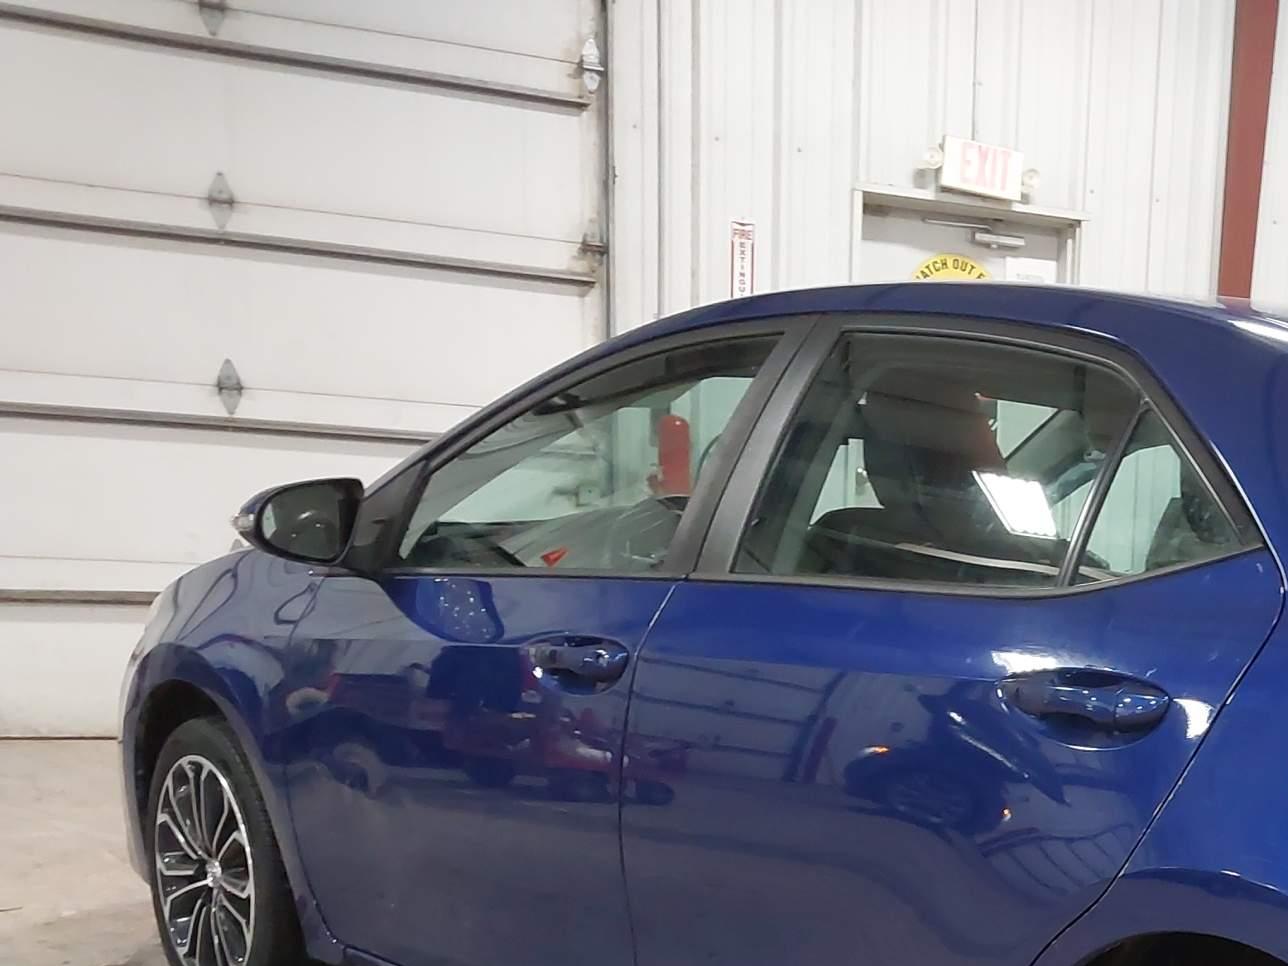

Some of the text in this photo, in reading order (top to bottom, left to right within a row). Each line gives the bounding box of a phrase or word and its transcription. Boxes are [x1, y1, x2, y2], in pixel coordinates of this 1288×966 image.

[960, 141, 1011, 192] EXIT
[733, 228, 753, 241] FIRE
[952, 258, 976, 276] OUT
